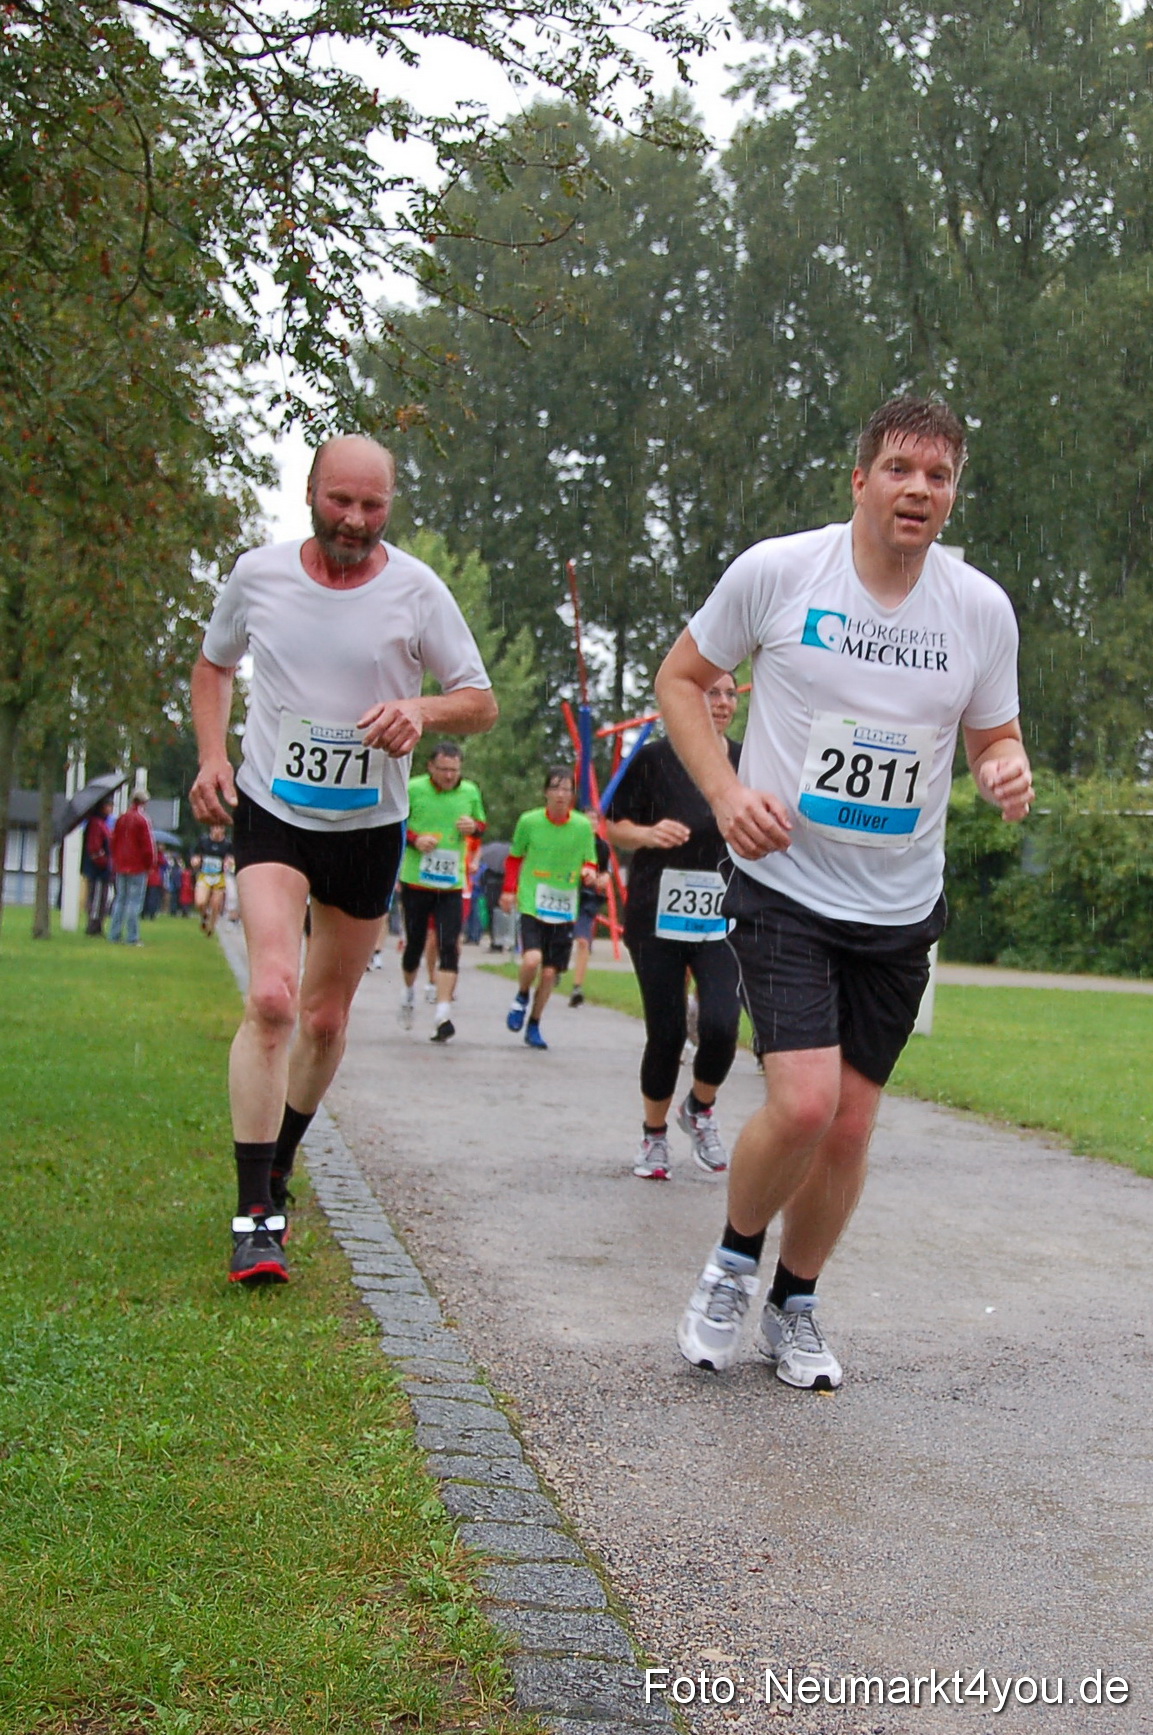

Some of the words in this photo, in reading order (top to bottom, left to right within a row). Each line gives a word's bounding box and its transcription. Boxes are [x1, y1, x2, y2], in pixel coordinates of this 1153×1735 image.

[847, 618, 948, 648] HÖRGERÄTE
[841, 635, 948, 672] MECKLER
[286, 741, 370, 785] 3371
[815, 748, 921, 804] 2811
[838, 807, 889, 830] Oliver
